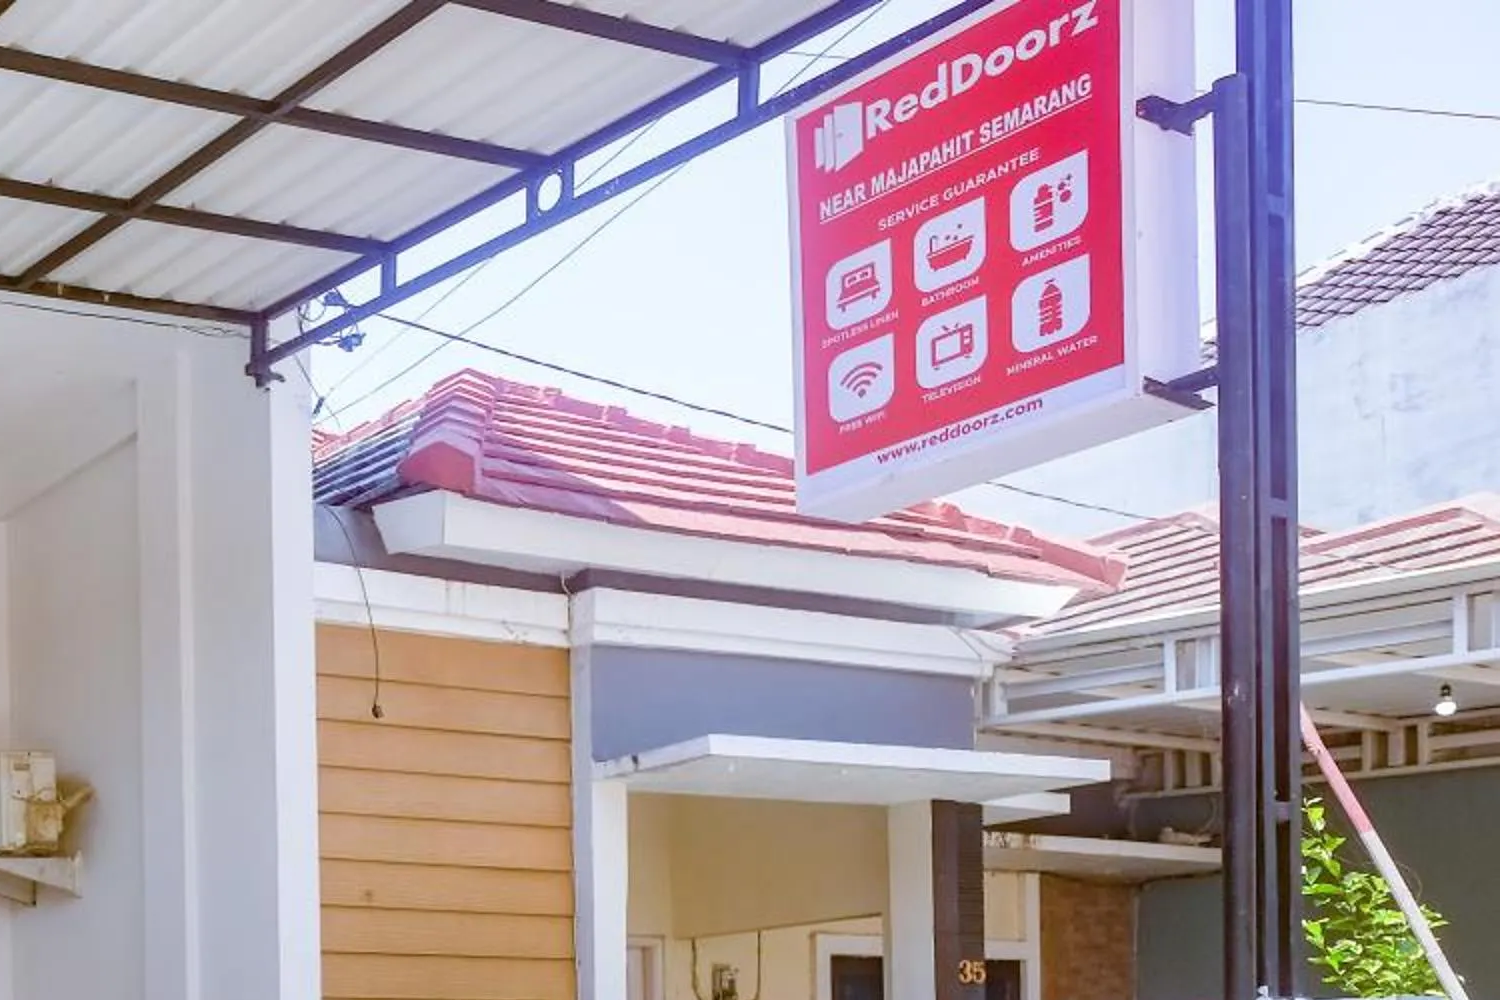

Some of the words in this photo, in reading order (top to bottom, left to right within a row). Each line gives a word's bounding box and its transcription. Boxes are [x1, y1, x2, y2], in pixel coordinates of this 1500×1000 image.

[867, 1, 1099, 140] RedDoorz
[819, 183, 867, 221] NEAR
[871, 131, 974, 197] MAJAPAHIT
[979, 73, 1093, 144] SEMARANG
[878, 194, 939, 231] SERVICE
[943, 147, 1040, 199] GUARANTEE
[920, 275, 980, 307] BATHROOM
[1057, 335, 1099, 356] WATER
[876, 398, 1044, 464] www.reddoorz.com
[958, 959, 987, 984] 35
